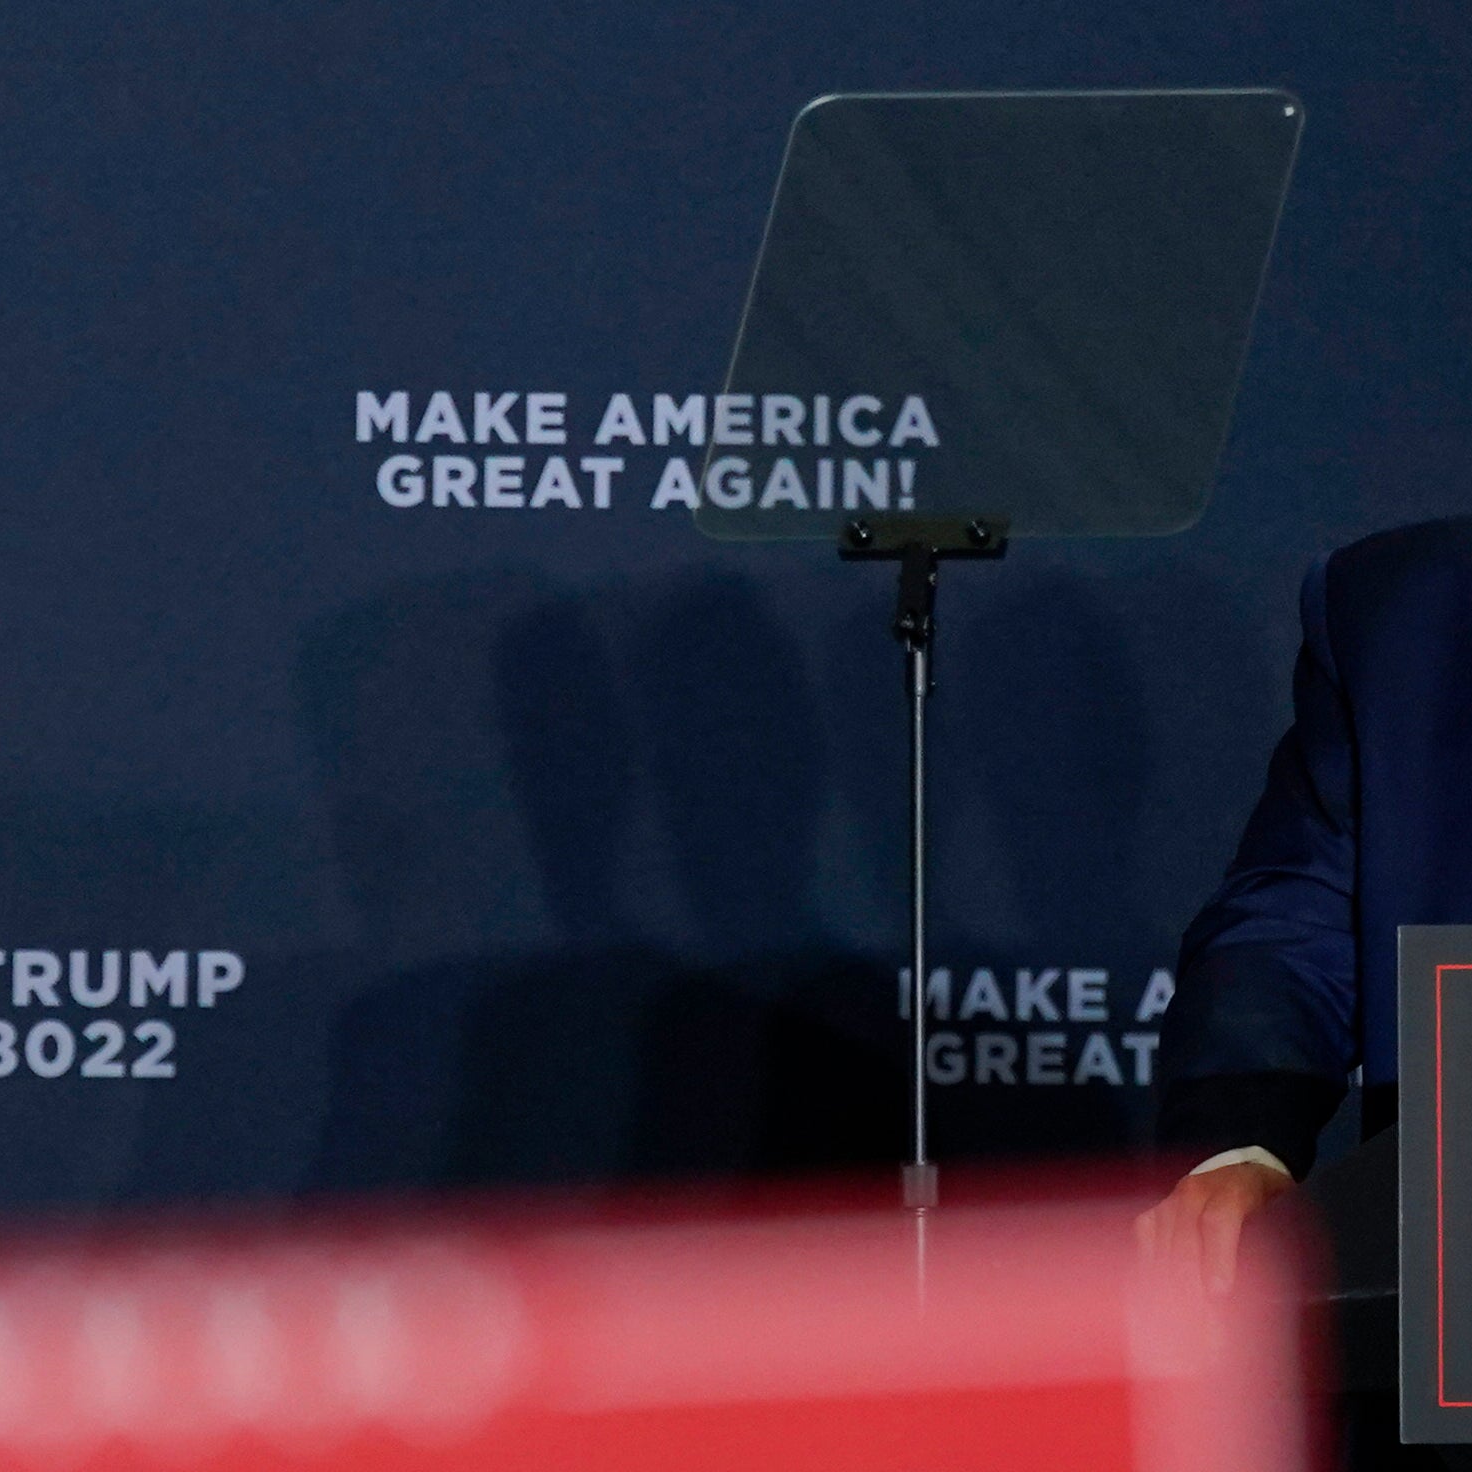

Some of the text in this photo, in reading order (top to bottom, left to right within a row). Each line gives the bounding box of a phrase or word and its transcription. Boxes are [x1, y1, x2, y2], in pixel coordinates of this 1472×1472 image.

[355, 390, 940, 447] MAKE AMERICA
[376, 454, 915, 510] GREAT AGAIN!
[898, 967, 1109, 1022] MAKE
[926, 1032, 1161, 1086] GREAT
